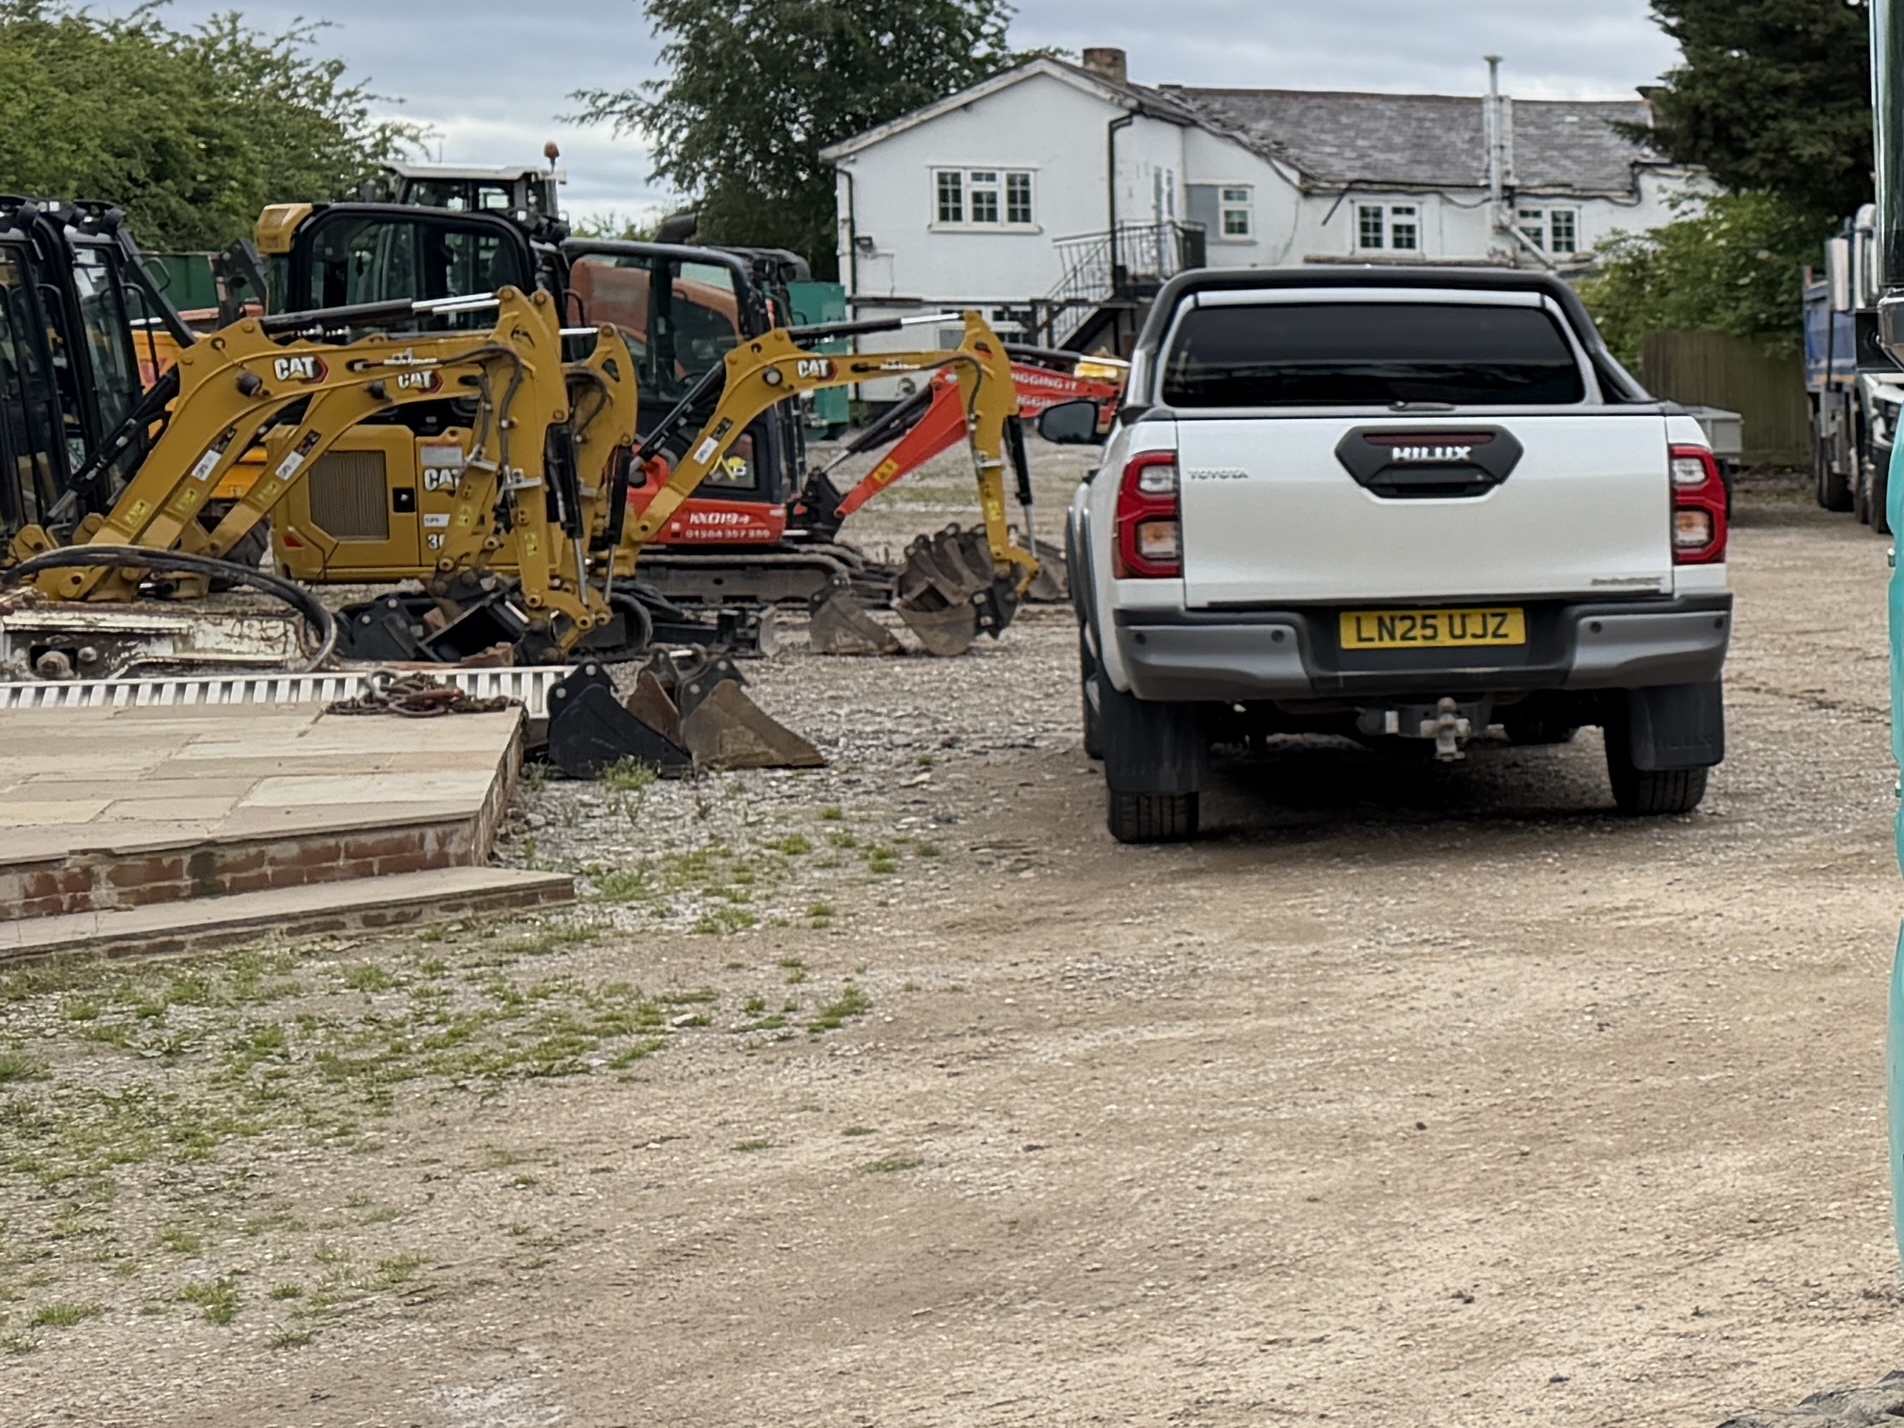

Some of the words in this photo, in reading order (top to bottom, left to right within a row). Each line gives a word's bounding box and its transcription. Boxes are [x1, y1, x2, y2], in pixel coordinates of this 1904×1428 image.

[274, 356, 315, 381] CAT
[797, 359, 829, 378] CAT
[398, 370, 433, 389] CAT
[1391, 446, 1472, 461] HILUX
[1187, 468, 1249, 480] TOYOTA
[1355, 614, 1439, 643] LN25
[1448, 612, 1510, 640] UJZ
